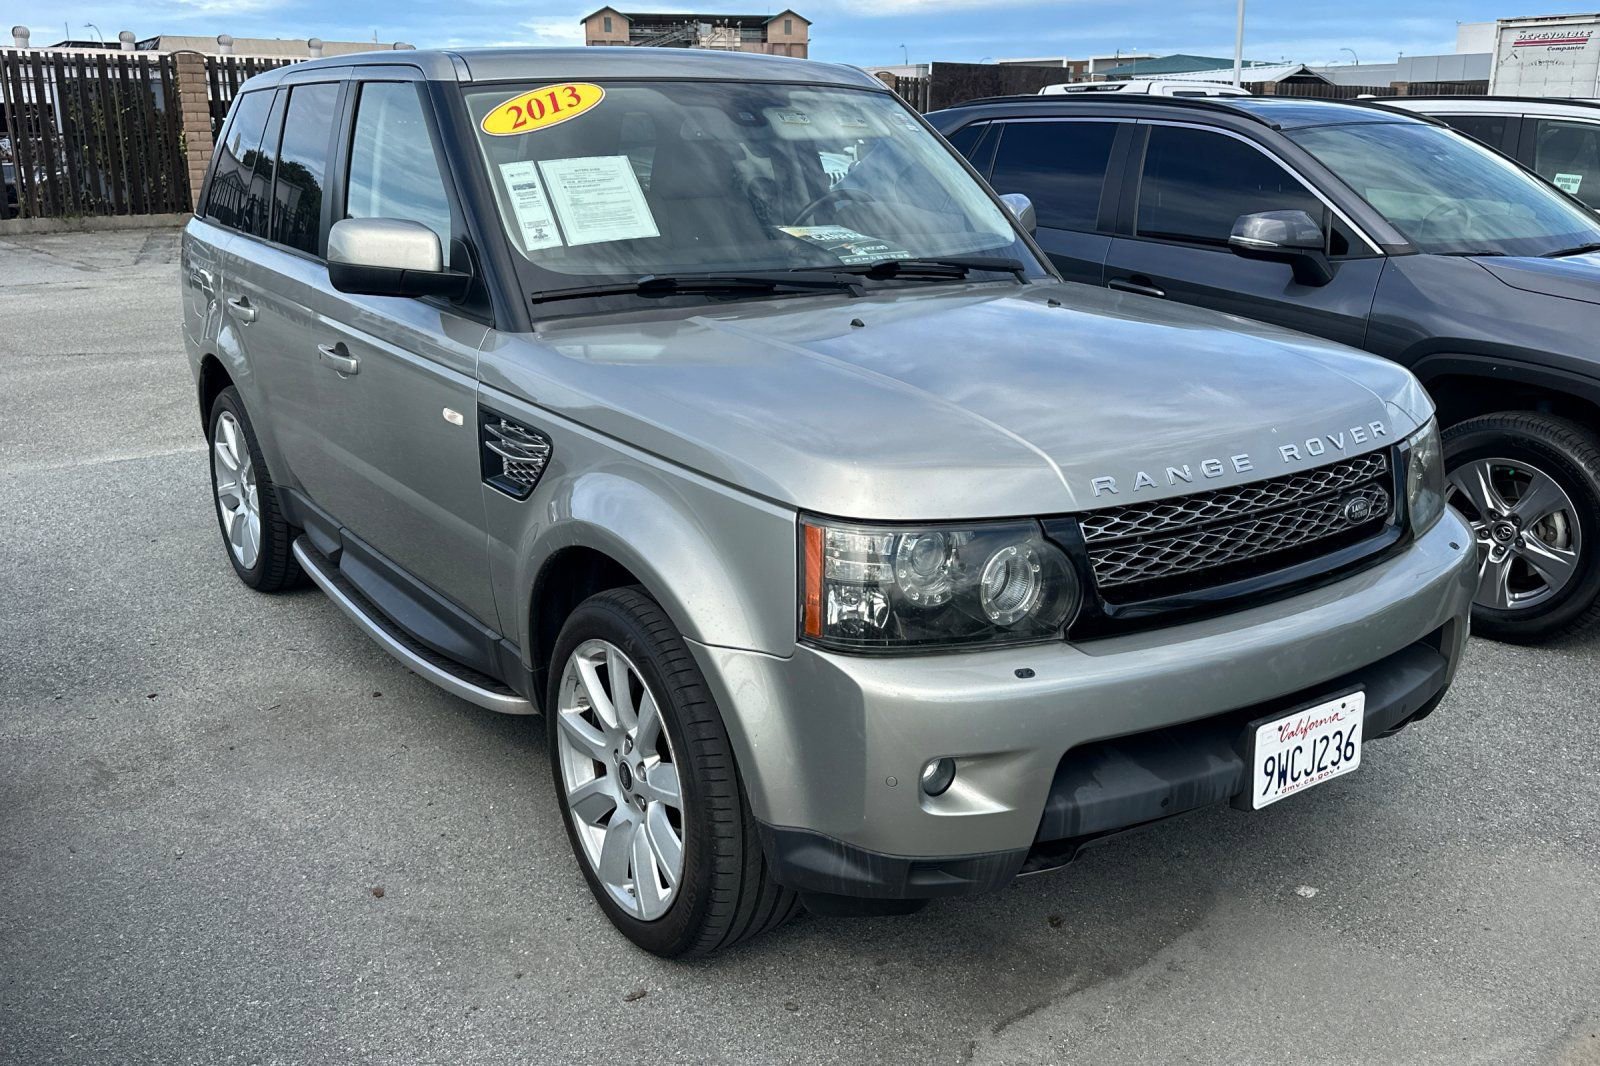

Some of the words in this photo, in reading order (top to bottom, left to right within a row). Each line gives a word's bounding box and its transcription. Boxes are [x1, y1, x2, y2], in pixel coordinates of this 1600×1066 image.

[506, 86, 582, 130] 2013
[1090, 453, 1253, 497] RANGE
[1278, 420, 1387, 463] ROVER
[1280, 709, 1346, 743] California
[1262, 724, 1357, 796] 9WCJ236
[1281, 769, 1335, 794] dmv.ca.gov
